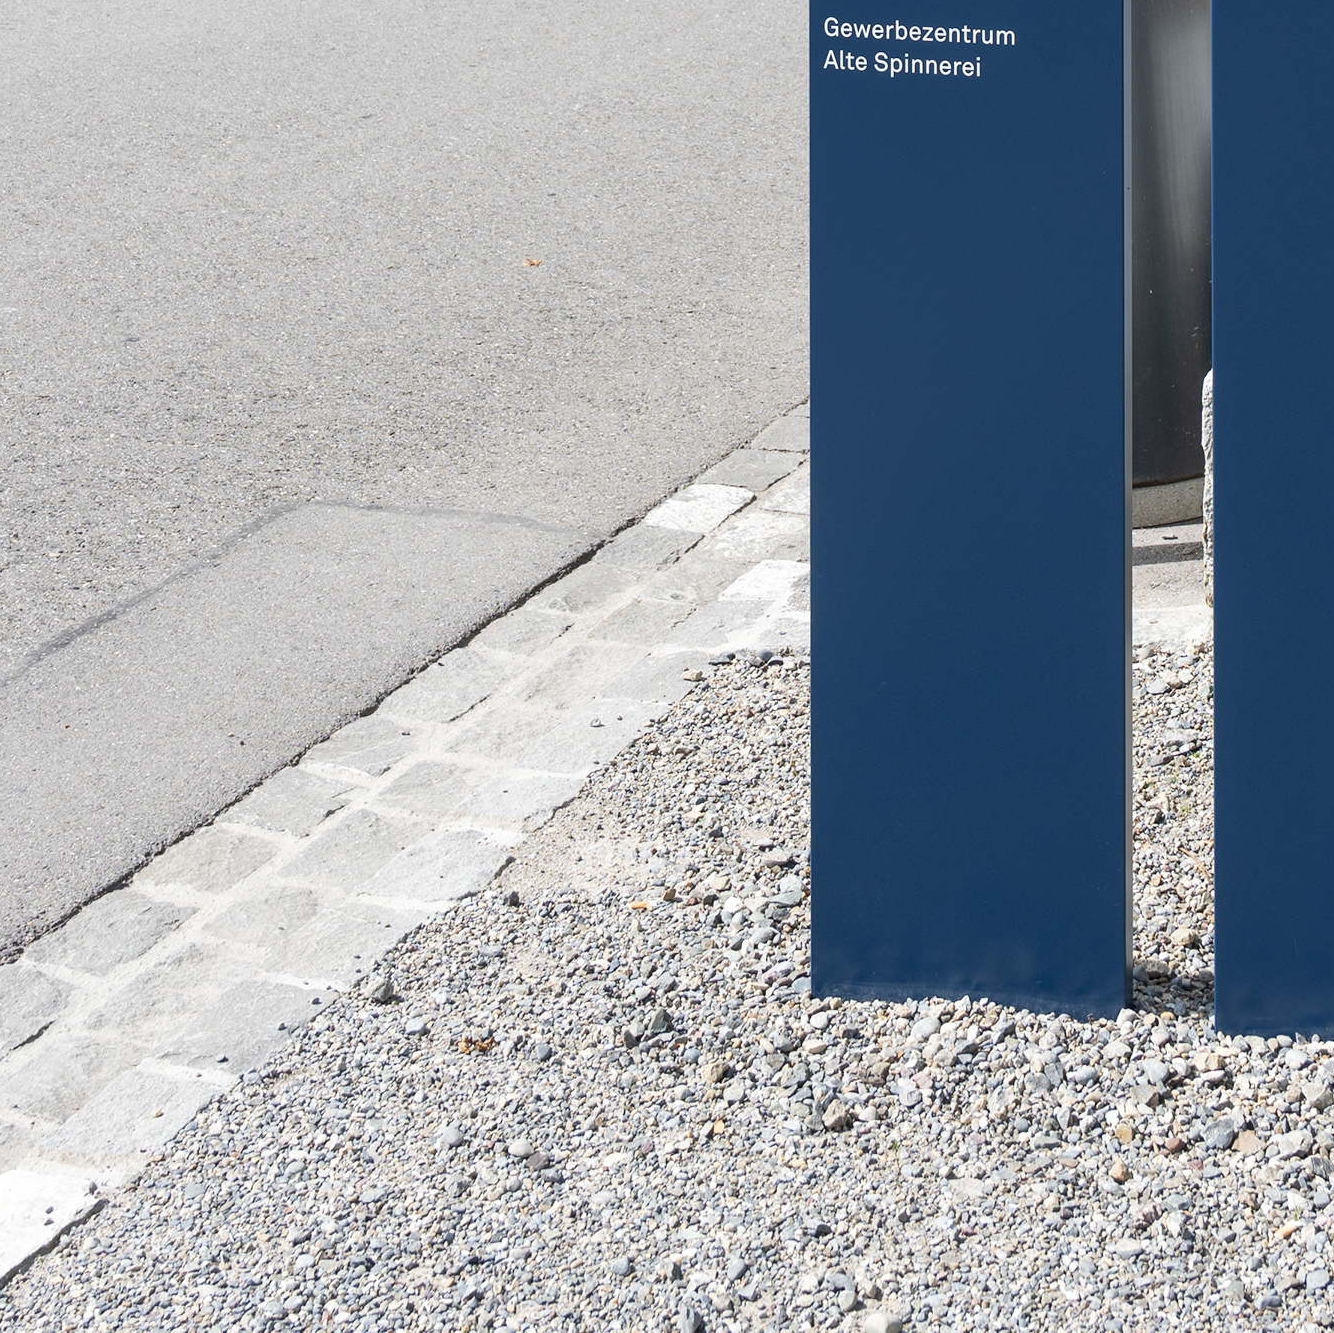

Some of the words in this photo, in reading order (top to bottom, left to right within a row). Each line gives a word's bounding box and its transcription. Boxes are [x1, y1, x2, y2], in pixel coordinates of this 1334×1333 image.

[824, 17, 1015, 46] Gewerbezentrum
[823, 49, 868, 71] Alte
[874, 52, 981, 78] Spinnerei
